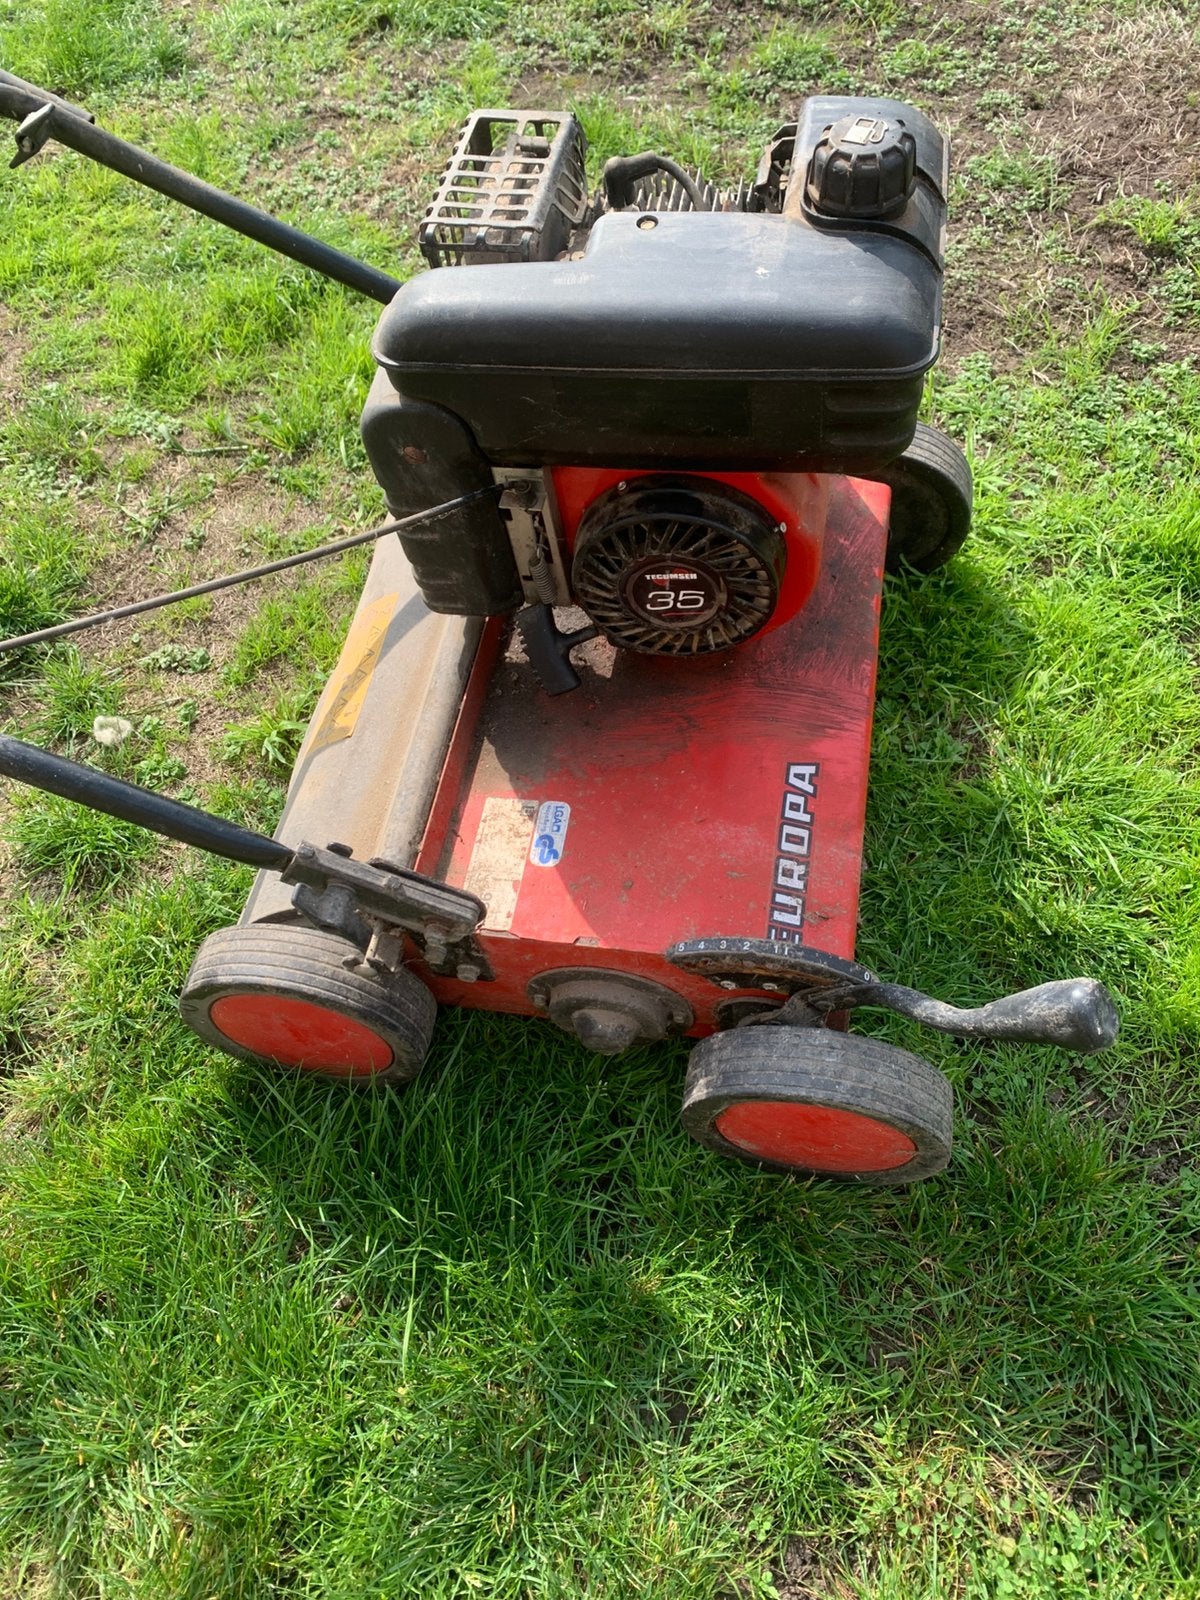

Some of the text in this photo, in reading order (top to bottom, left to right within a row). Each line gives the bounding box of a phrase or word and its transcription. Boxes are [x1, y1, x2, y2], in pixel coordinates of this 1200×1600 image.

[646, 590, 705, 610] 35
[678, 942, 685, 951] 5
[698, 941, 705, 949] 4
[720, 940, 727, 949] 3
[743, 941, 751, 950] 2
[864, 971, 871, 981] 0
